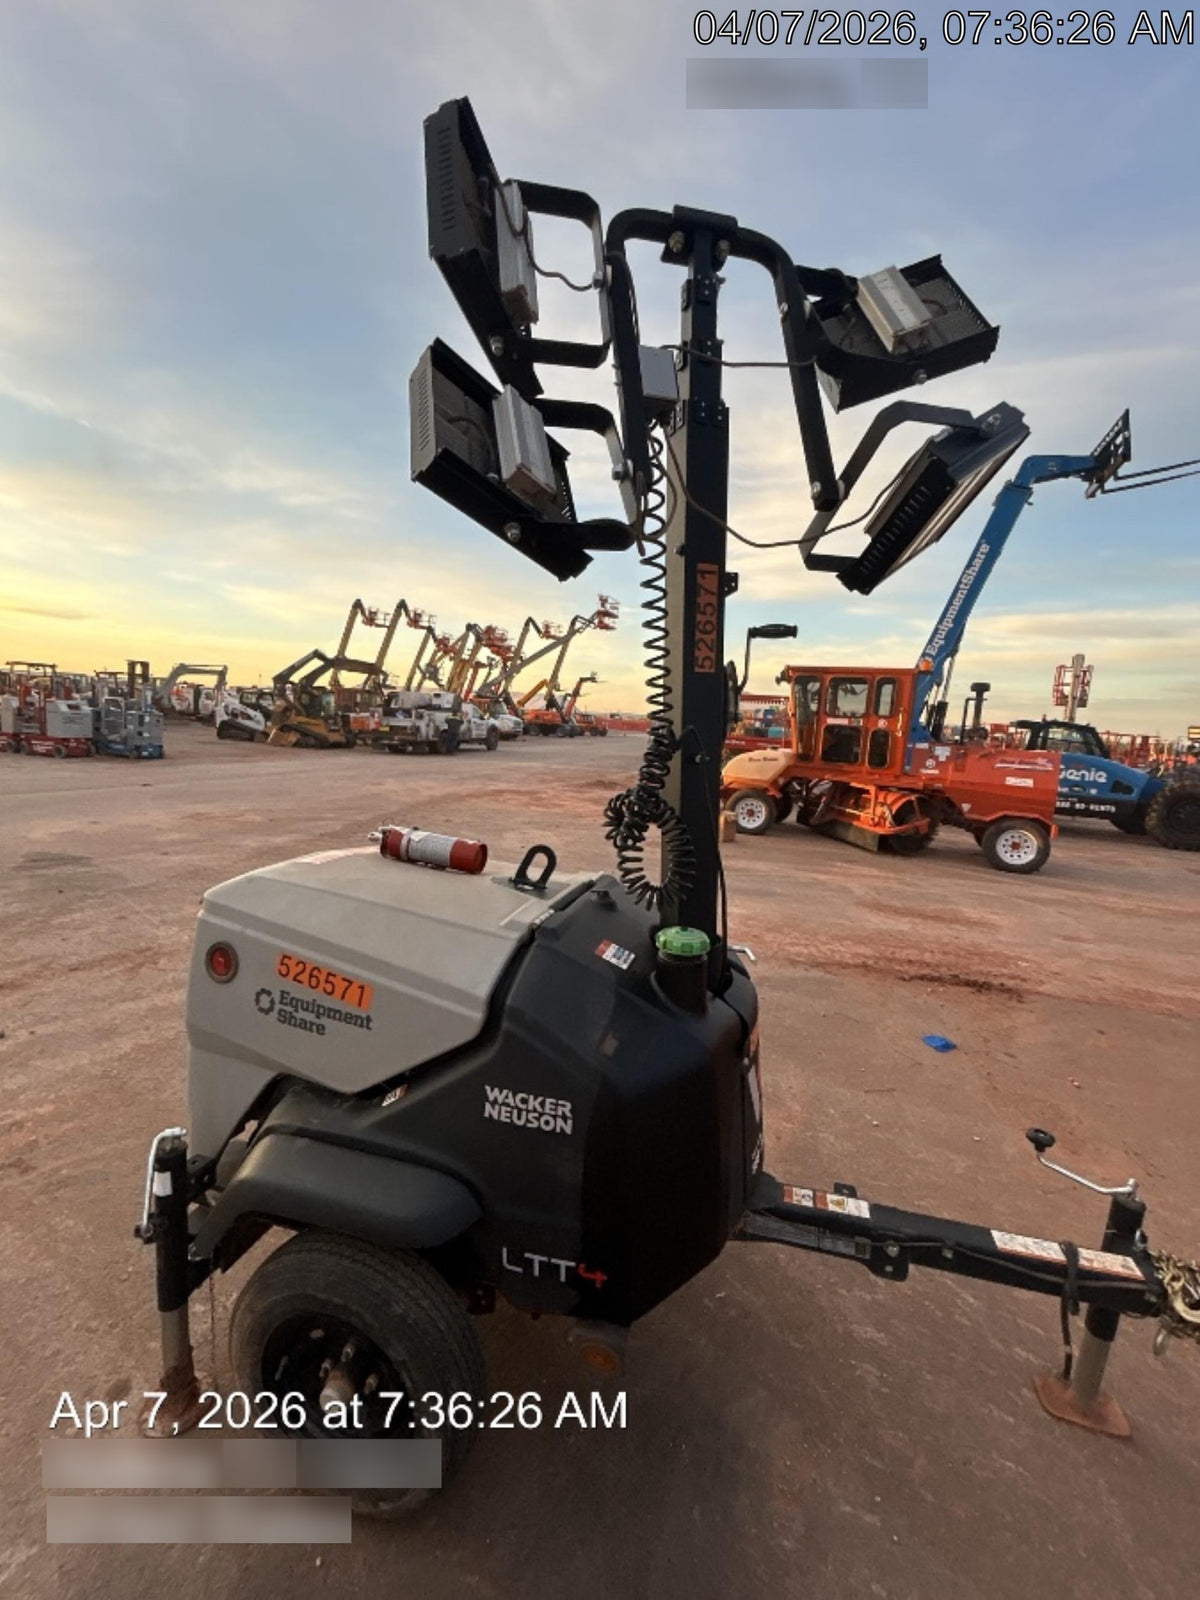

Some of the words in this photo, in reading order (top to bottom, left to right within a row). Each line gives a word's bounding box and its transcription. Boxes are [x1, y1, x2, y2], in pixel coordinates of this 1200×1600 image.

[697, 567, 717, 670] 526571
[925, 543, 990, 656] EquipmentShare
[278, 954, 366, 1008] 526571
[277, 1009, 326, 1036] Share
[279, 990, 373, 1031] Equipment
[484, 1084, 573, 1118] WACKER
[484, 1101, 573, 1135] NEUSON
